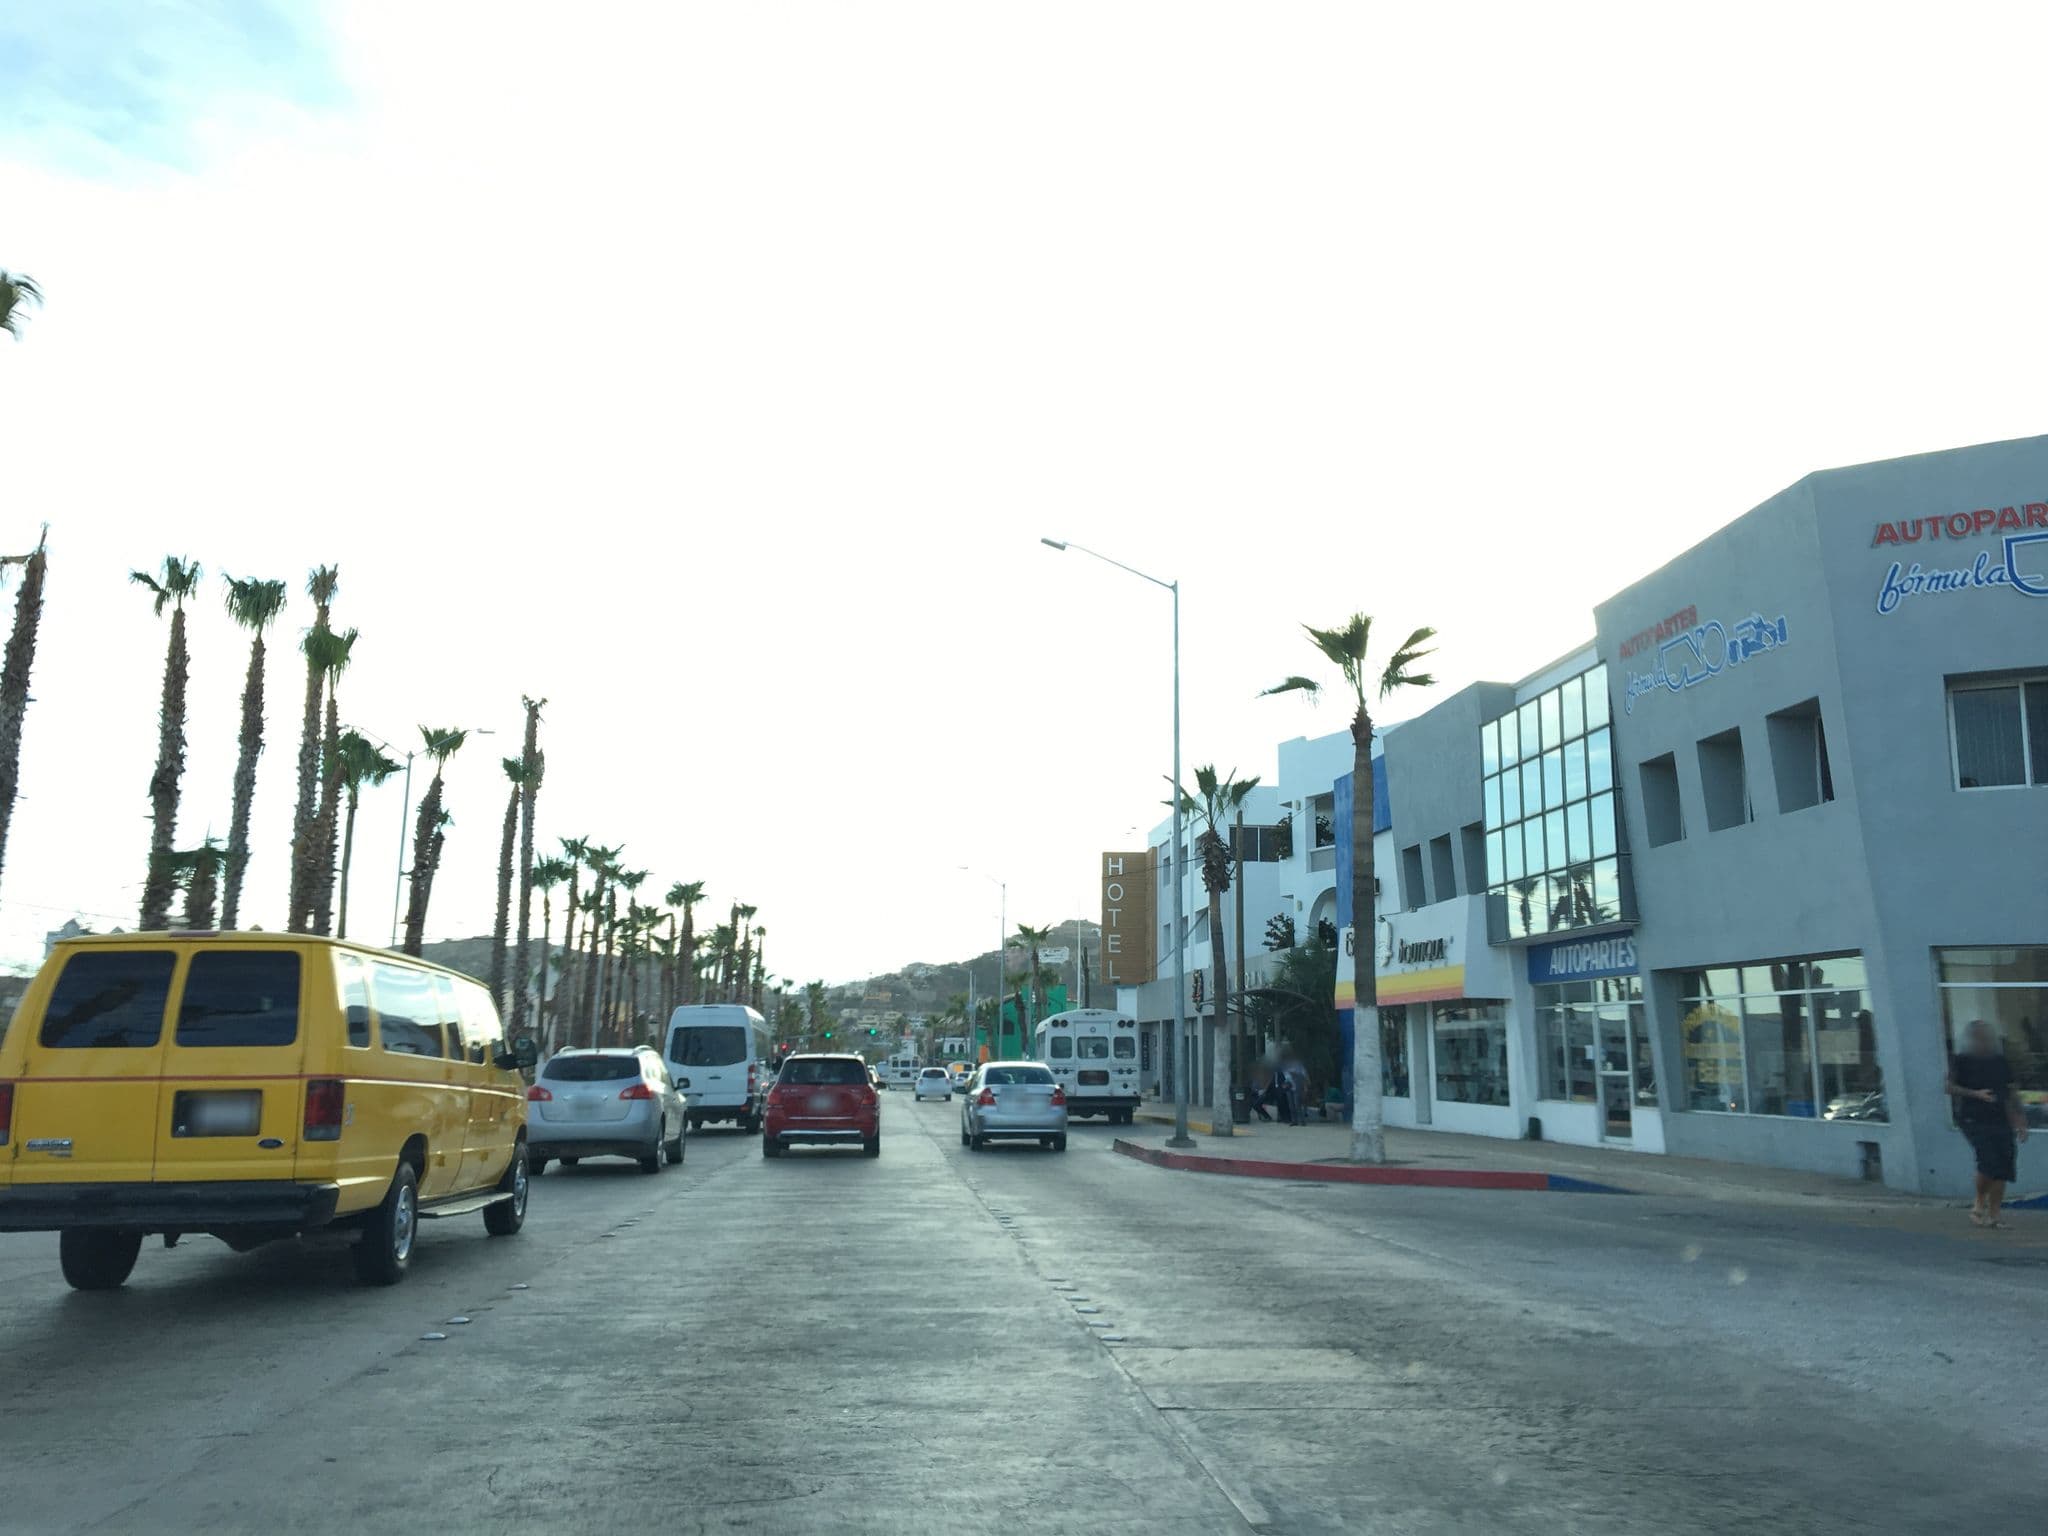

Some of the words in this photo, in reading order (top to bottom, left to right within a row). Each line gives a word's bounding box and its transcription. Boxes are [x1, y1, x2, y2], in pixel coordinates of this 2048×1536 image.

[1877, 550, 2013, 615] fórmula
[1107, 857, 1124, 980] HOTEL
[1549, 936, 1638, 975] AUTOPARTES
